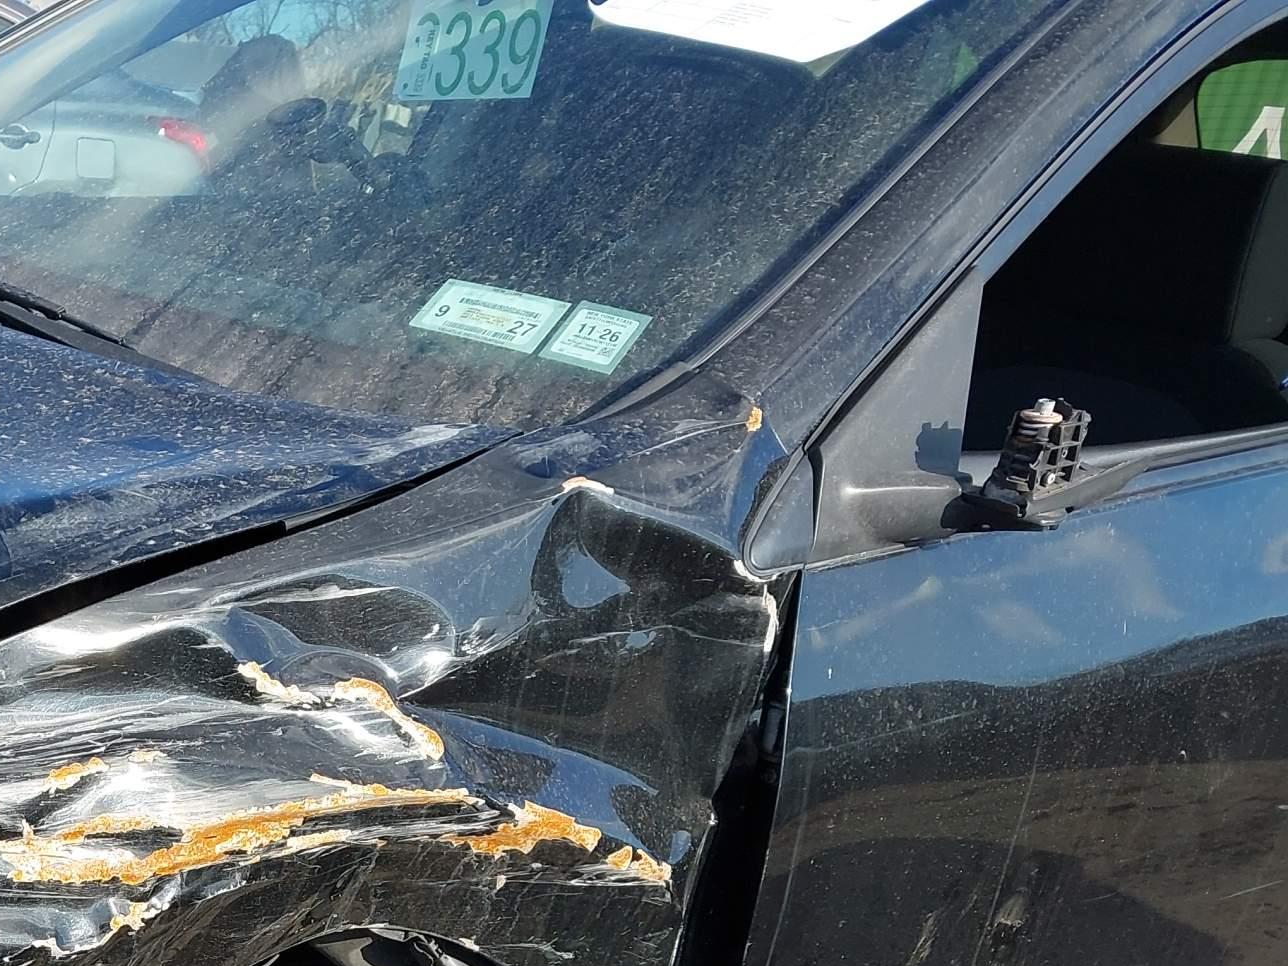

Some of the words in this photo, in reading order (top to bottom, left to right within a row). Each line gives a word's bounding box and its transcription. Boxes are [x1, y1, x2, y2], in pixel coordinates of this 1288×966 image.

[434, 304, 451, 318] 9
[506, 320, 539, 337] 27
[578, 322, 597, 337] 11
[598, 328, 623, 343] 26
